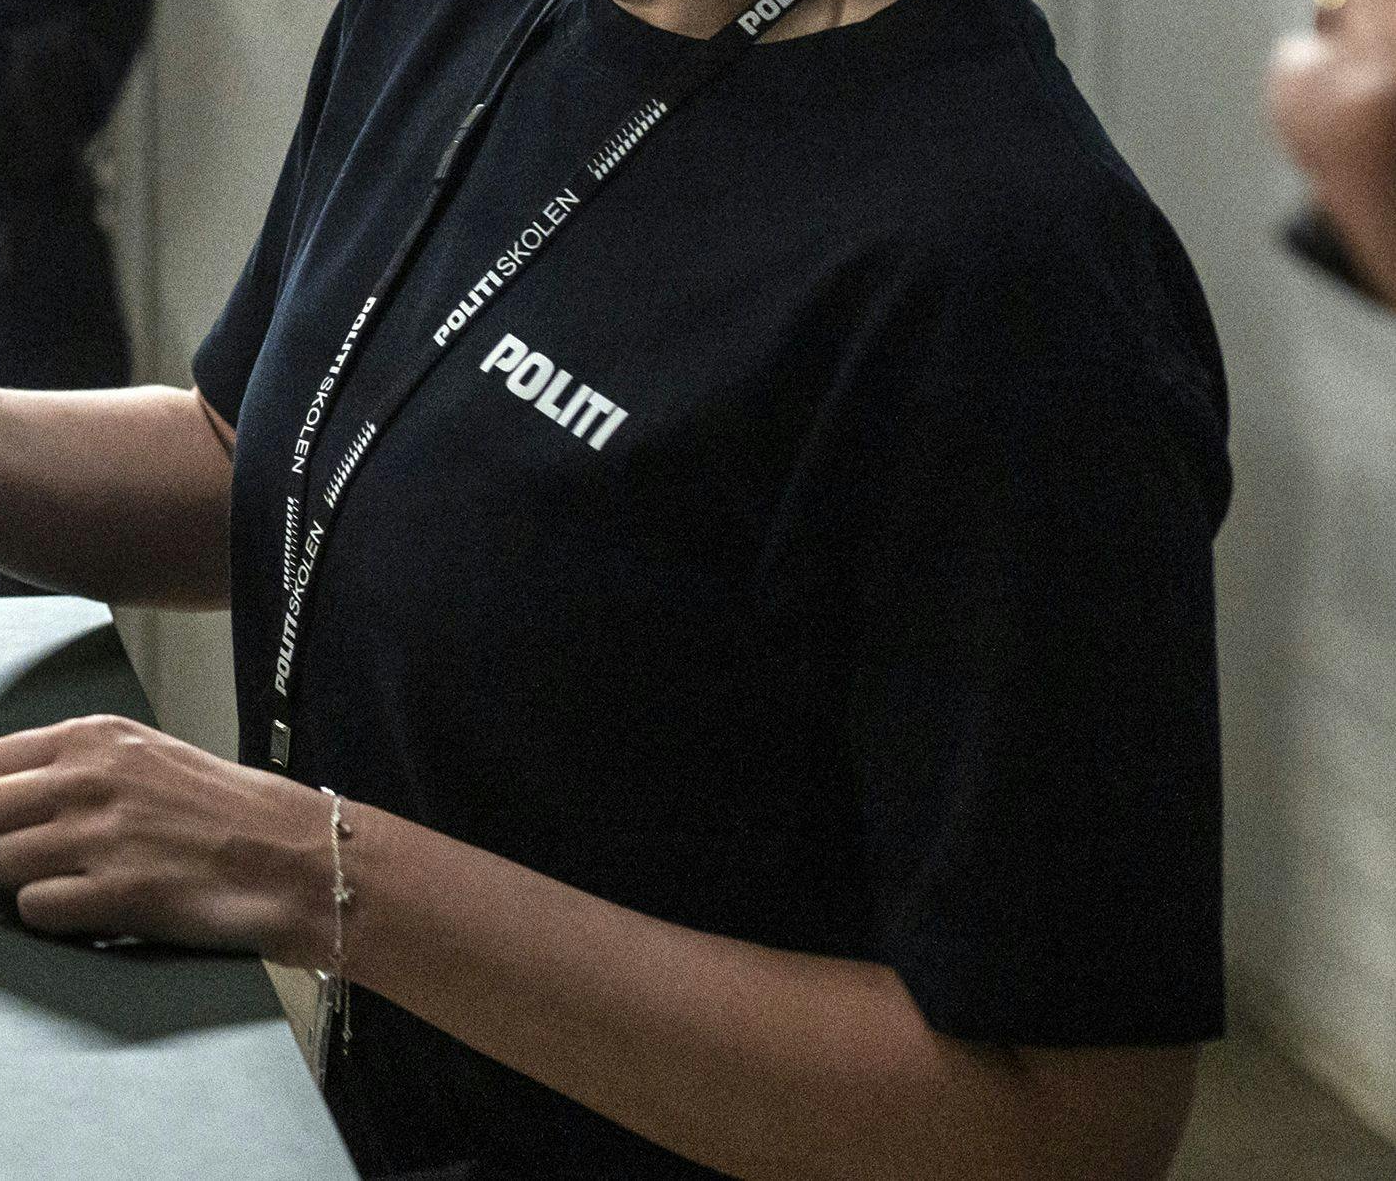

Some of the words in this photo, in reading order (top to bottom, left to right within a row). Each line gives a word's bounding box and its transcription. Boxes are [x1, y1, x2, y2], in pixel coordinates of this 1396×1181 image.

[433, 188, 581, 347] POLITISKOLEN
[292, 297, 377, 474] POLITISKOLEN
[479, 333, 629, 451] POLITI
[274, 520, 325, 696] POLITISKOLEN
